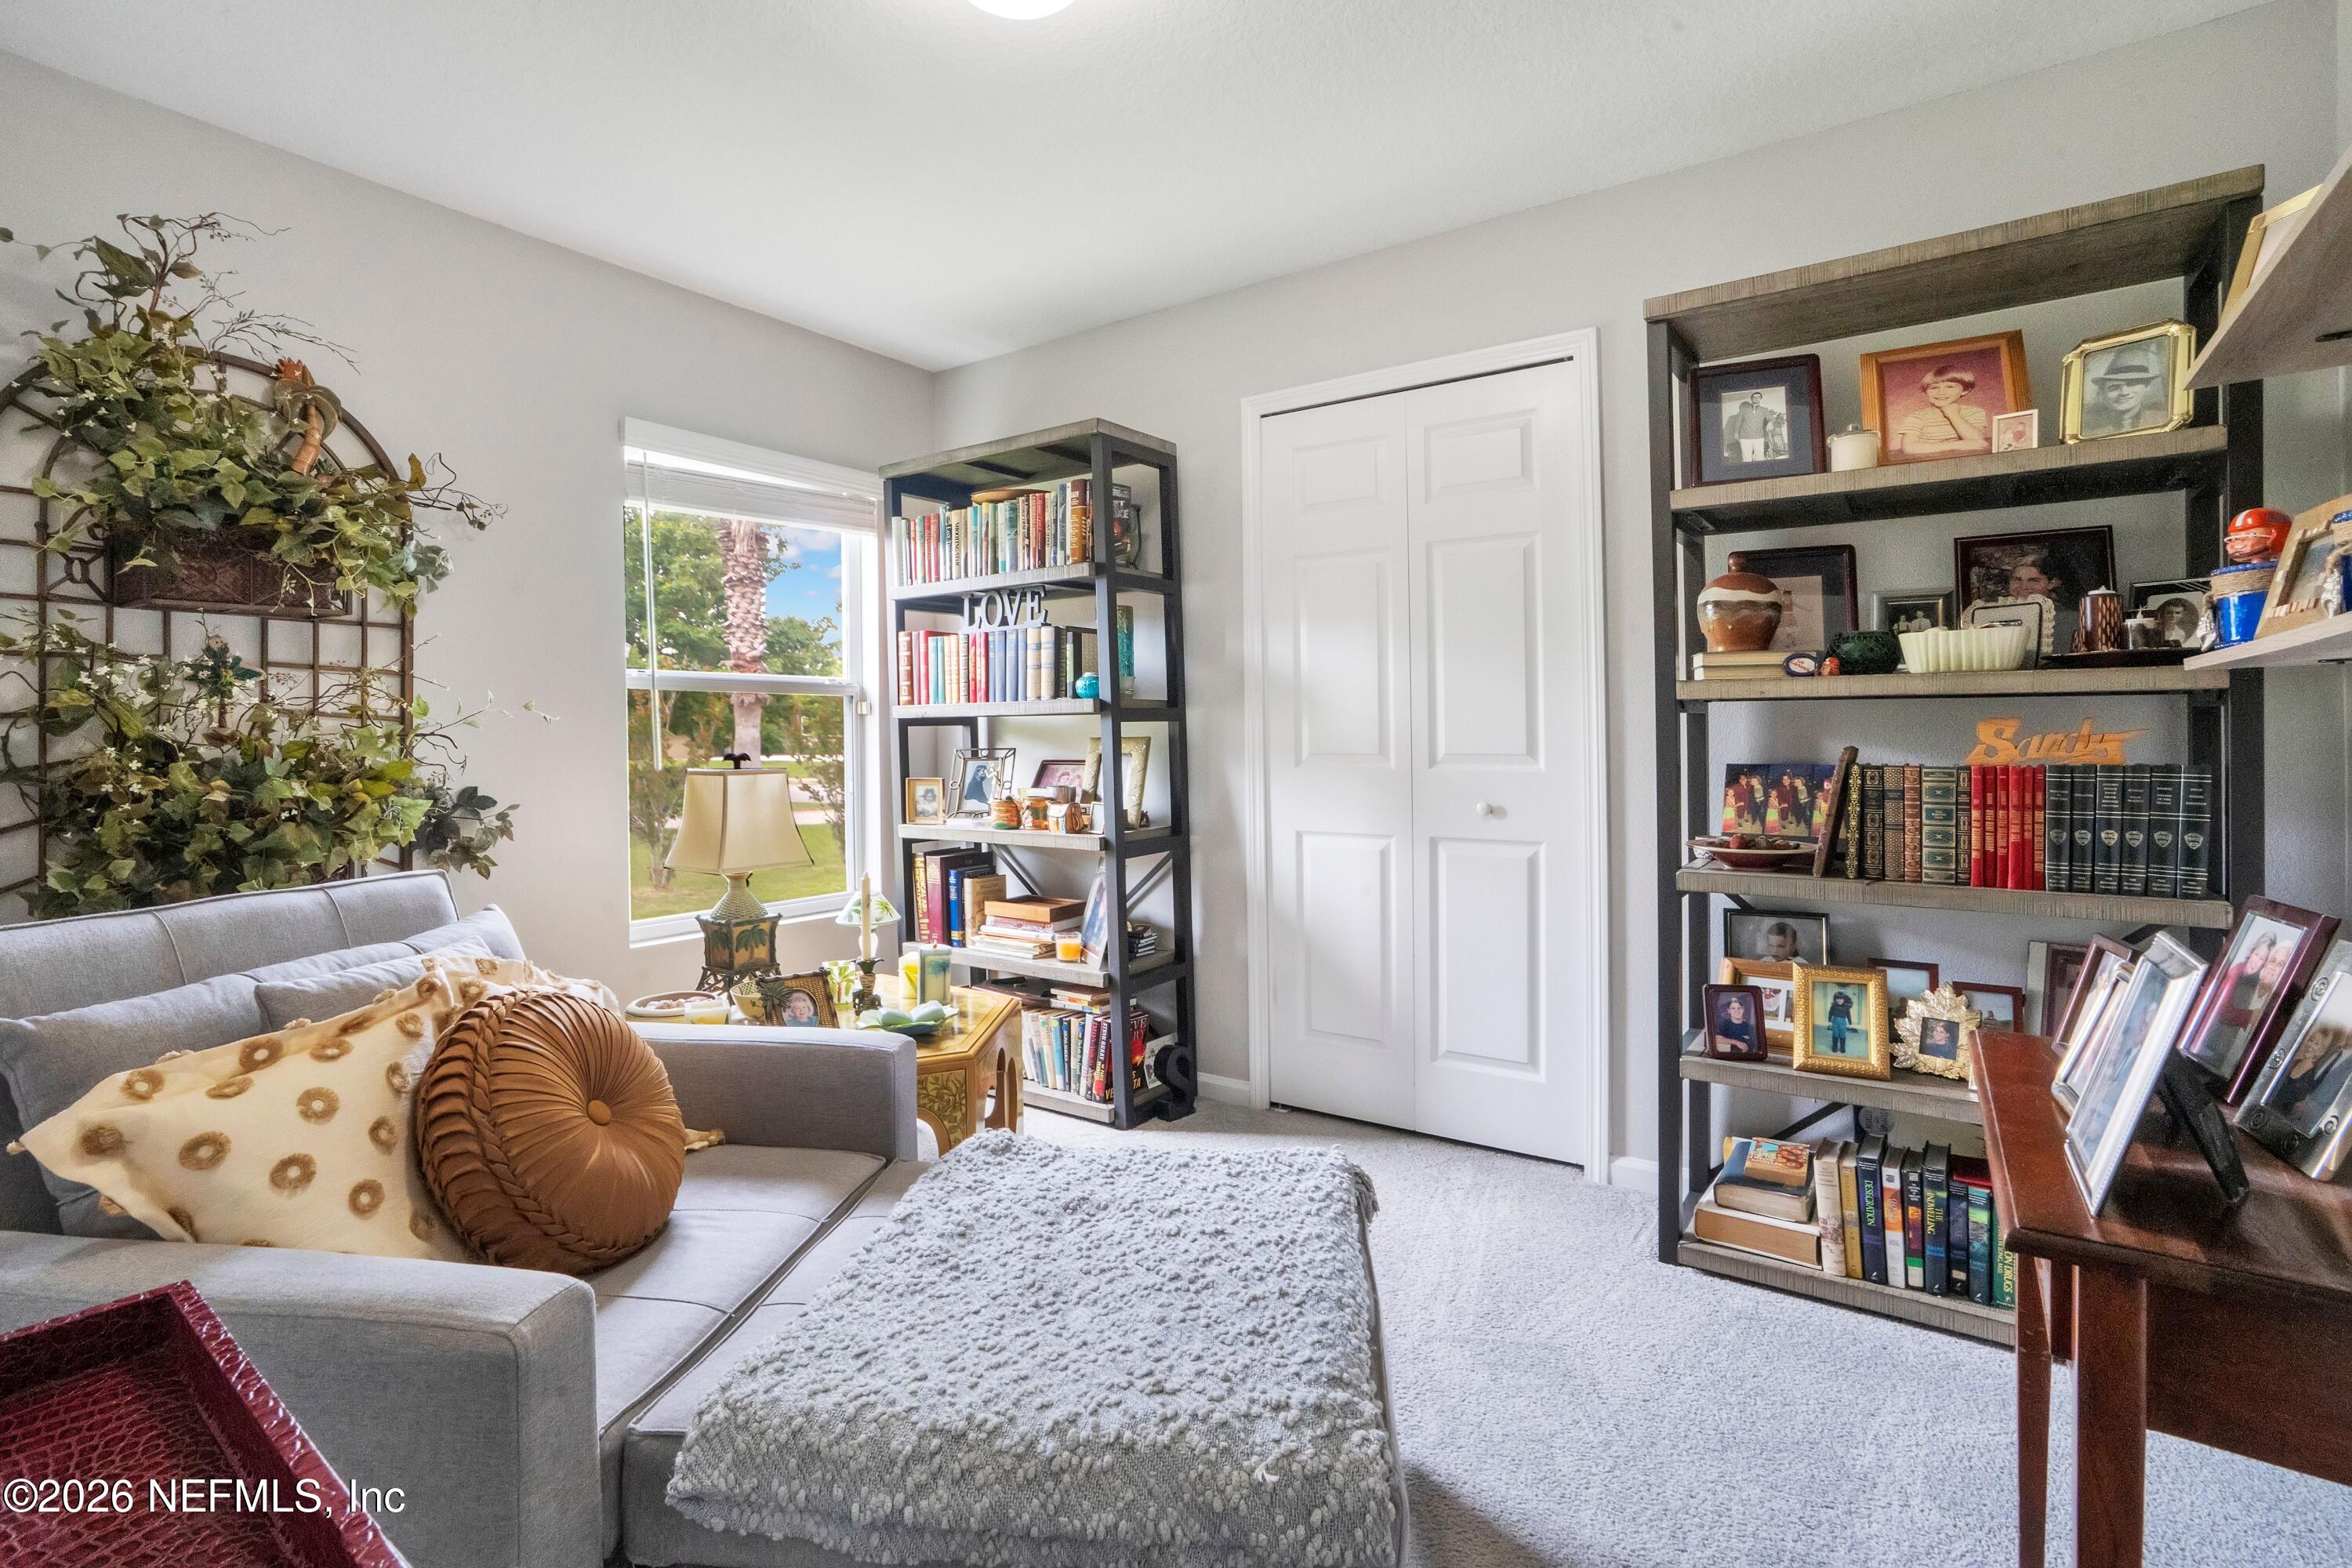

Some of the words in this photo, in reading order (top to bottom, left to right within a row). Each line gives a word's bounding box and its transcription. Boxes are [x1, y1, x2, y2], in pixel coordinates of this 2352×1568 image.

[961, 584, 1047, 630] LOVE
[1864, 1180, 1875, 1226] DESECRATION
[1926, 1192, 1936, 1236] INDWELLING
[2003, 1264, 2013, 1294] DRUGS
[2005, 1250, 2013, 1264] ON
